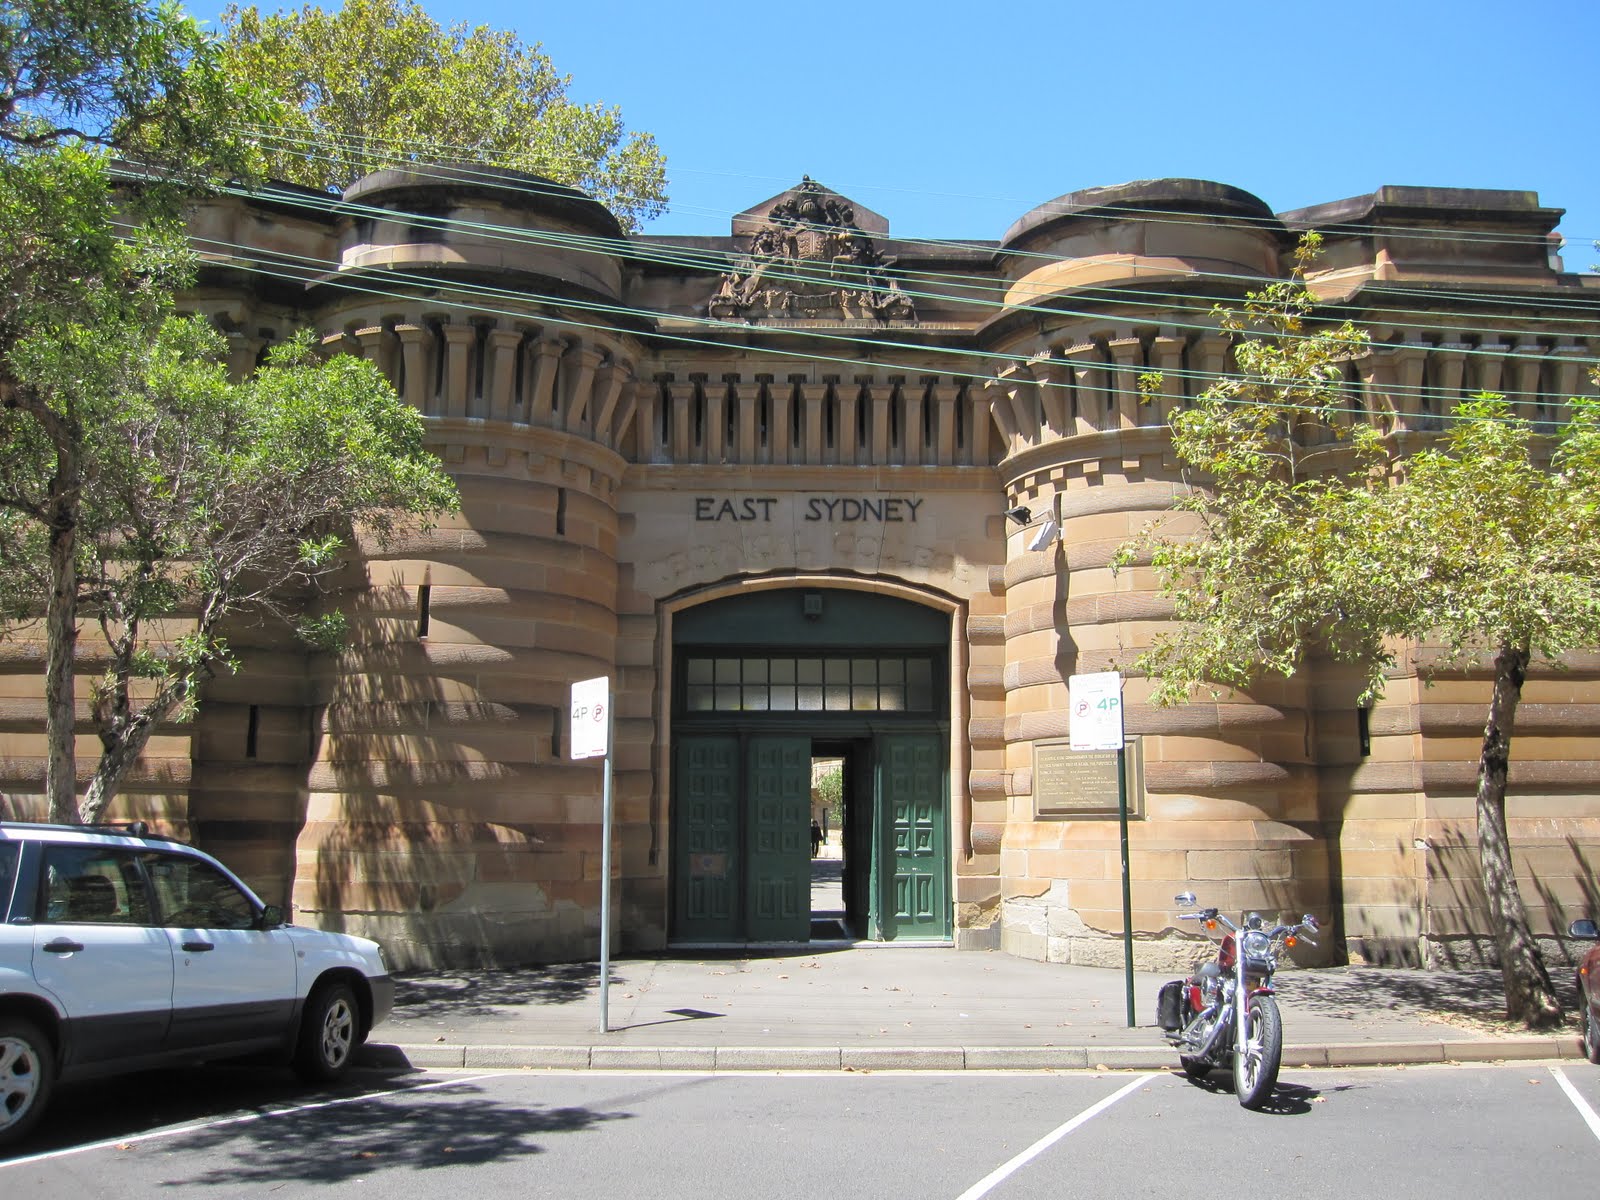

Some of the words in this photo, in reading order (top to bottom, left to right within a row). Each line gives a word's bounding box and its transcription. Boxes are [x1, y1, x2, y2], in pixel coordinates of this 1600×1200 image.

[695, 498, 778, 521] EAST
[805, 498, 924, 522] SYDNEY
[1097, 698, 1119, 710] 4P
[573, 707, 588, 720] 4P
